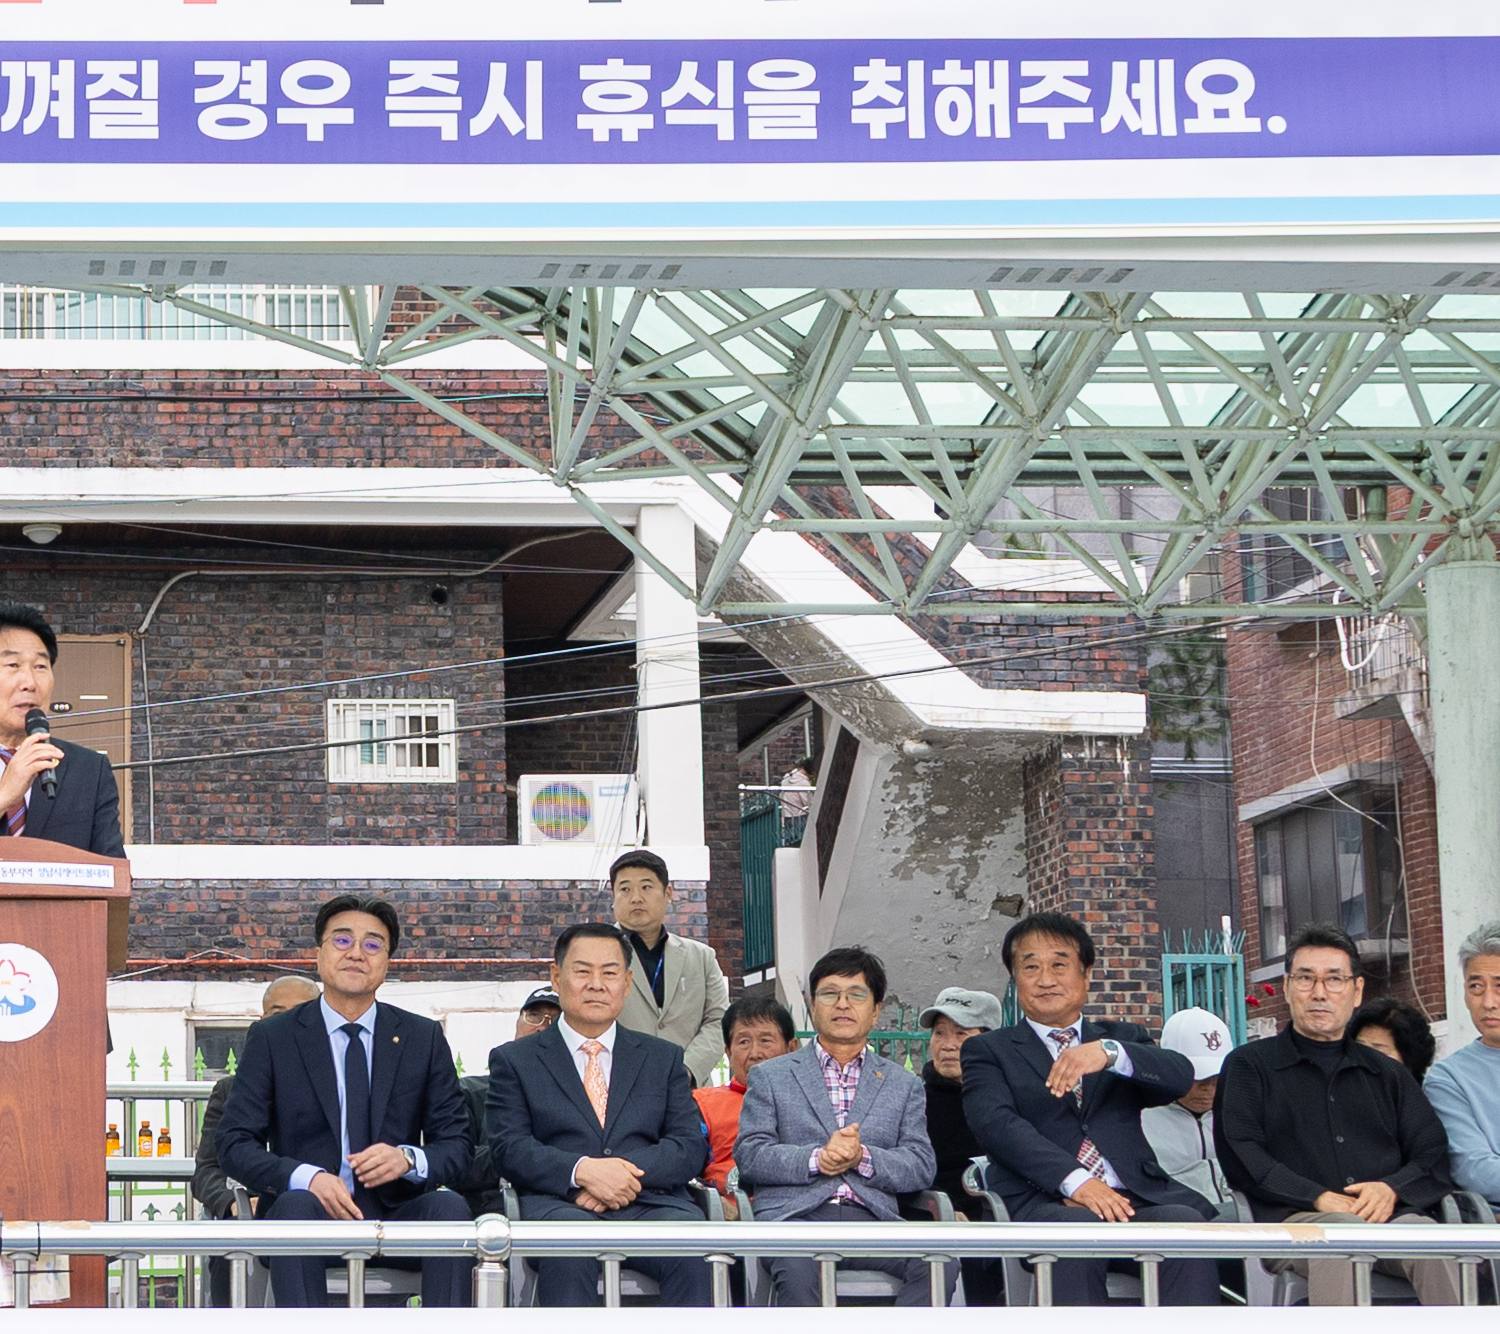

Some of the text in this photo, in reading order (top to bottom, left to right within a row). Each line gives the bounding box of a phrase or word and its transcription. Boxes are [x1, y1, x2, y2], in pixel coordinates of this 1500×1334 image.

[193, 60, 355, 142] 경우
[384, 60, 544, 141] 즉시
[576, 60, 821, 141] 휴식을
[850, 57, 1288, 140] 취해주세요.
[1, 867, 33, 879] 동부지역
